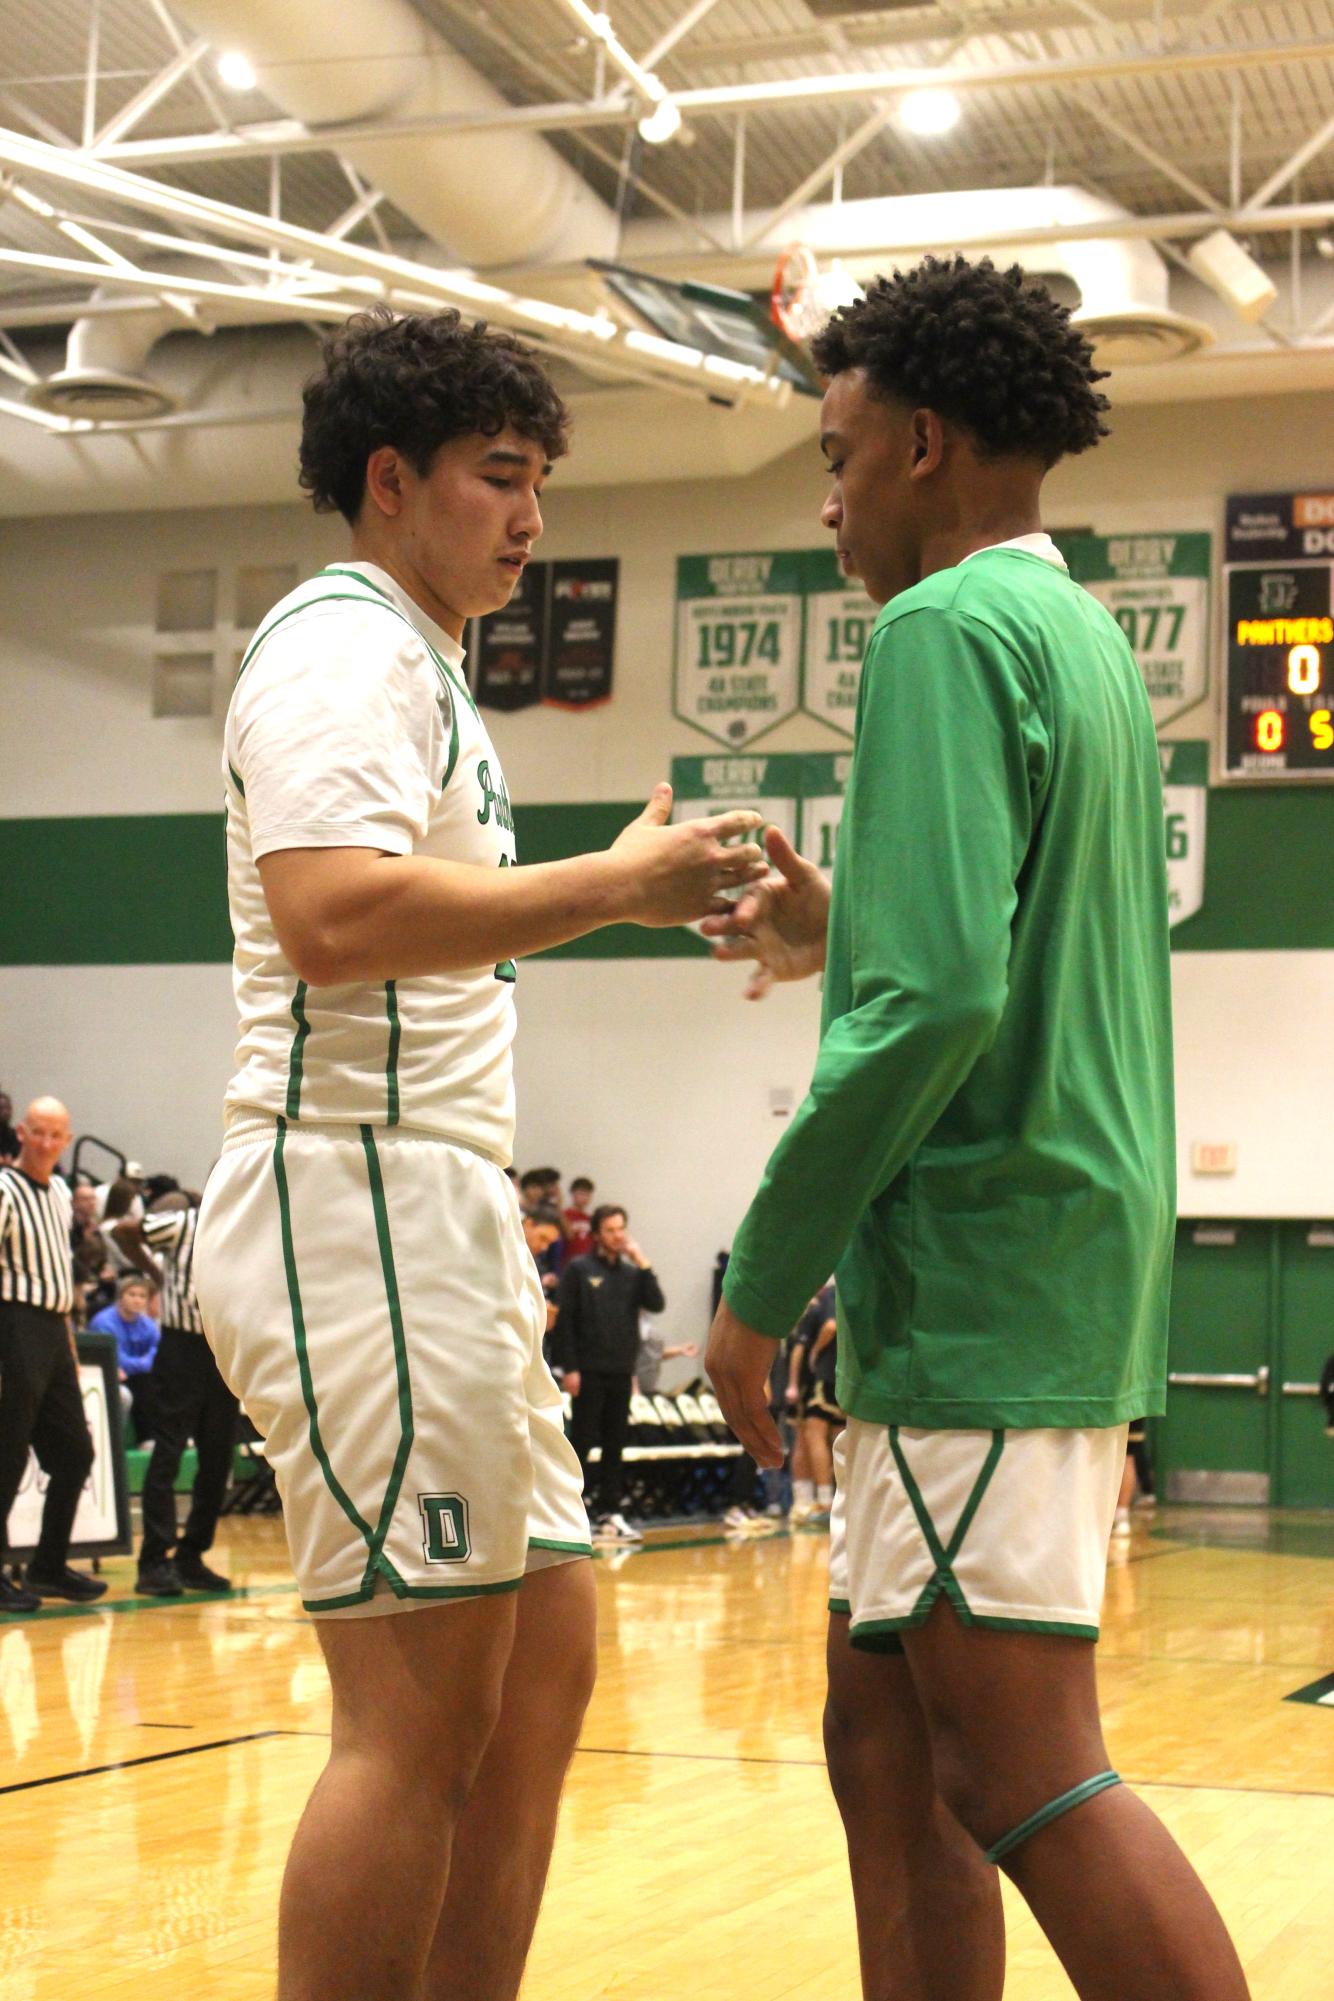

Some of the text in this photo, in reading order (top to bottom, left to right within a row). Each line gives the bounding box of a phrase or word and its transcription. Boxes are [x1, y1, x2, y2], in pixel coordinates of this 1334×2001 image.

[697, 621, 780, 669] 1974
[827, 616, 877, 663] 19
[1237, 617, 1334, 647] PANTHERS
[1288, 644, 1320, 695] 0
[1257, 711, 1284, 751] 0
[417, 1492, 472, 1565] D
